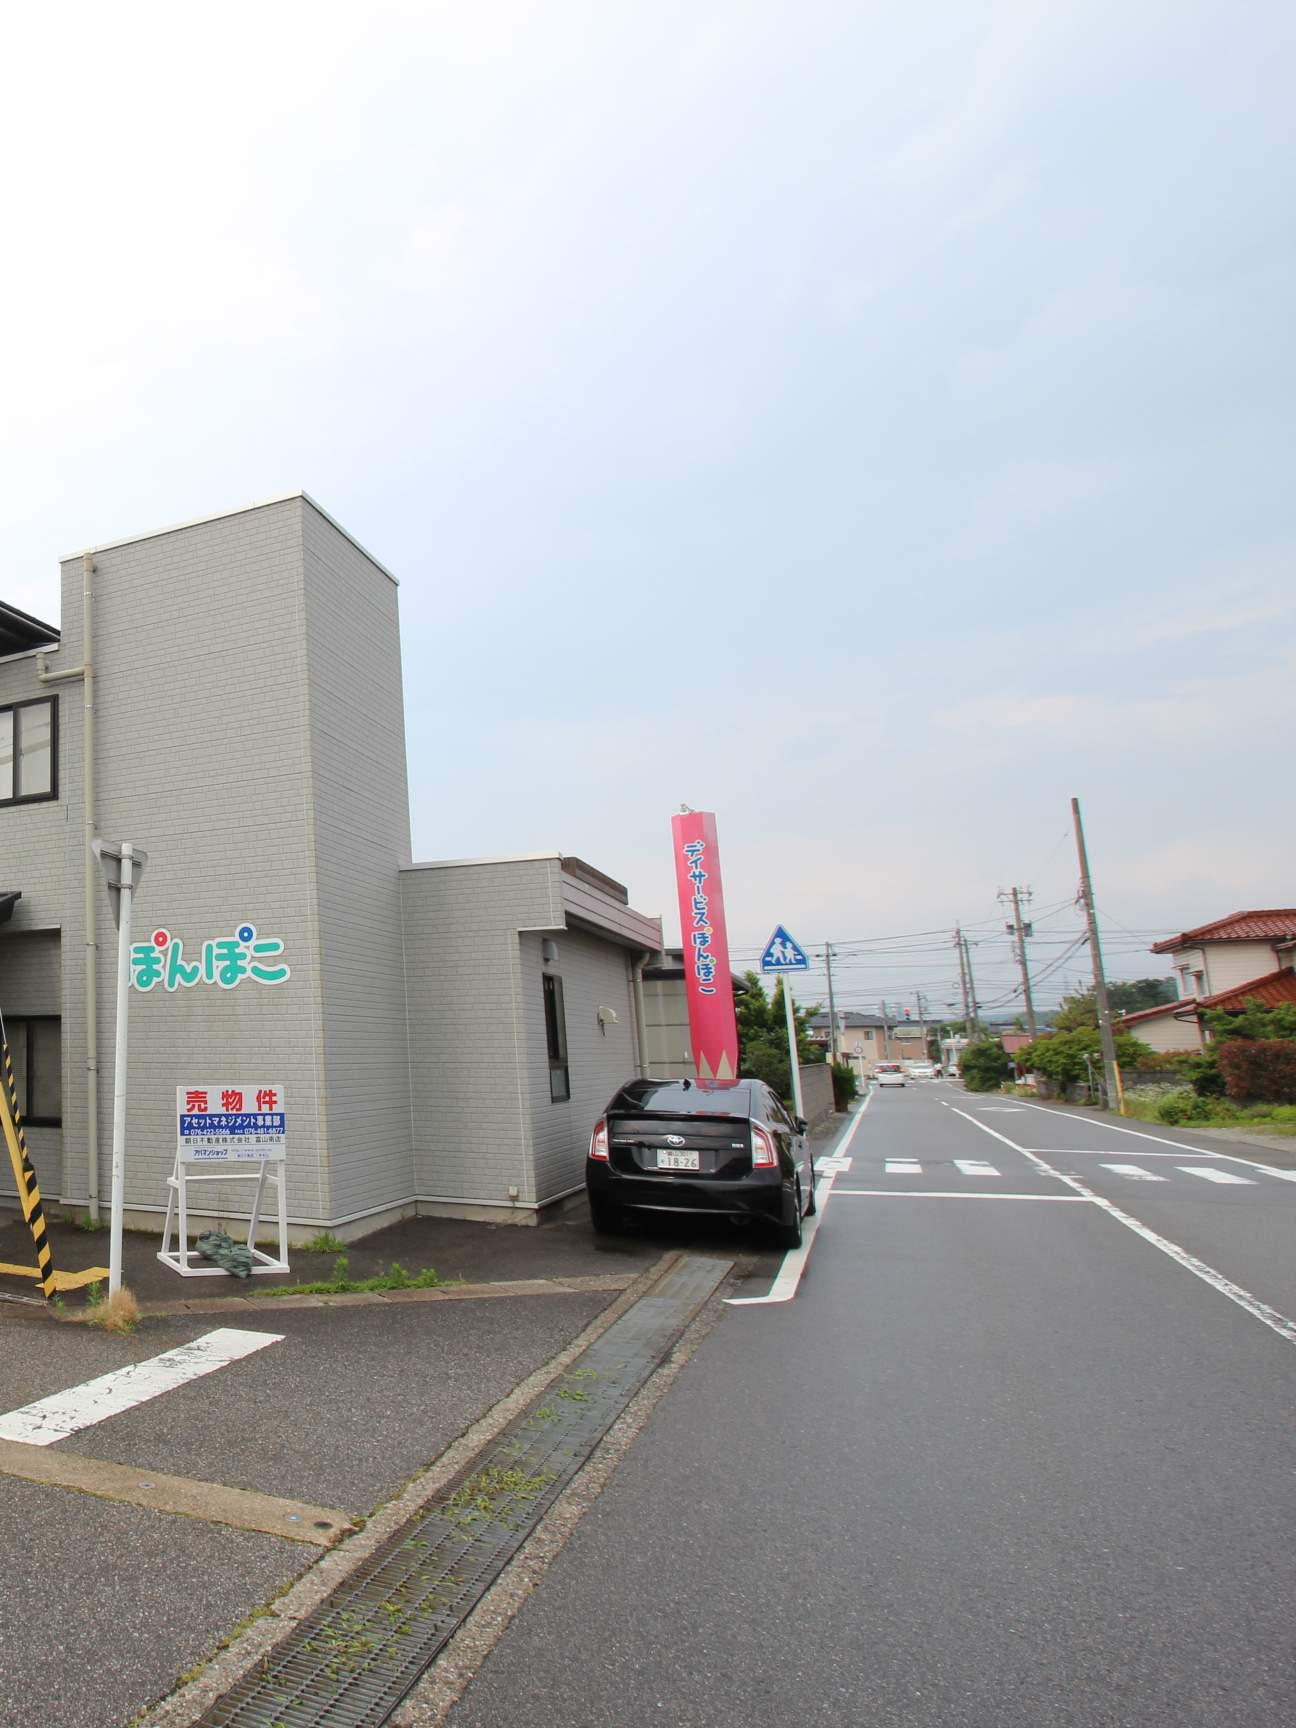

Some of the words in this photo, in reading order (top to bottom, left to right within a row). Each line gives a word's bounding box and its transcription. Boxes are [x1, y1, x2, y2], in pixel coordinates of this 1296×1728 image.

[684, 840, 708, 926] デイサービス
[128, 924, 289, 991] ぽんぽこ
[692, 927, 716, 994] ぽんぽこ
[185, 1089, 278, 1113] 売物件
